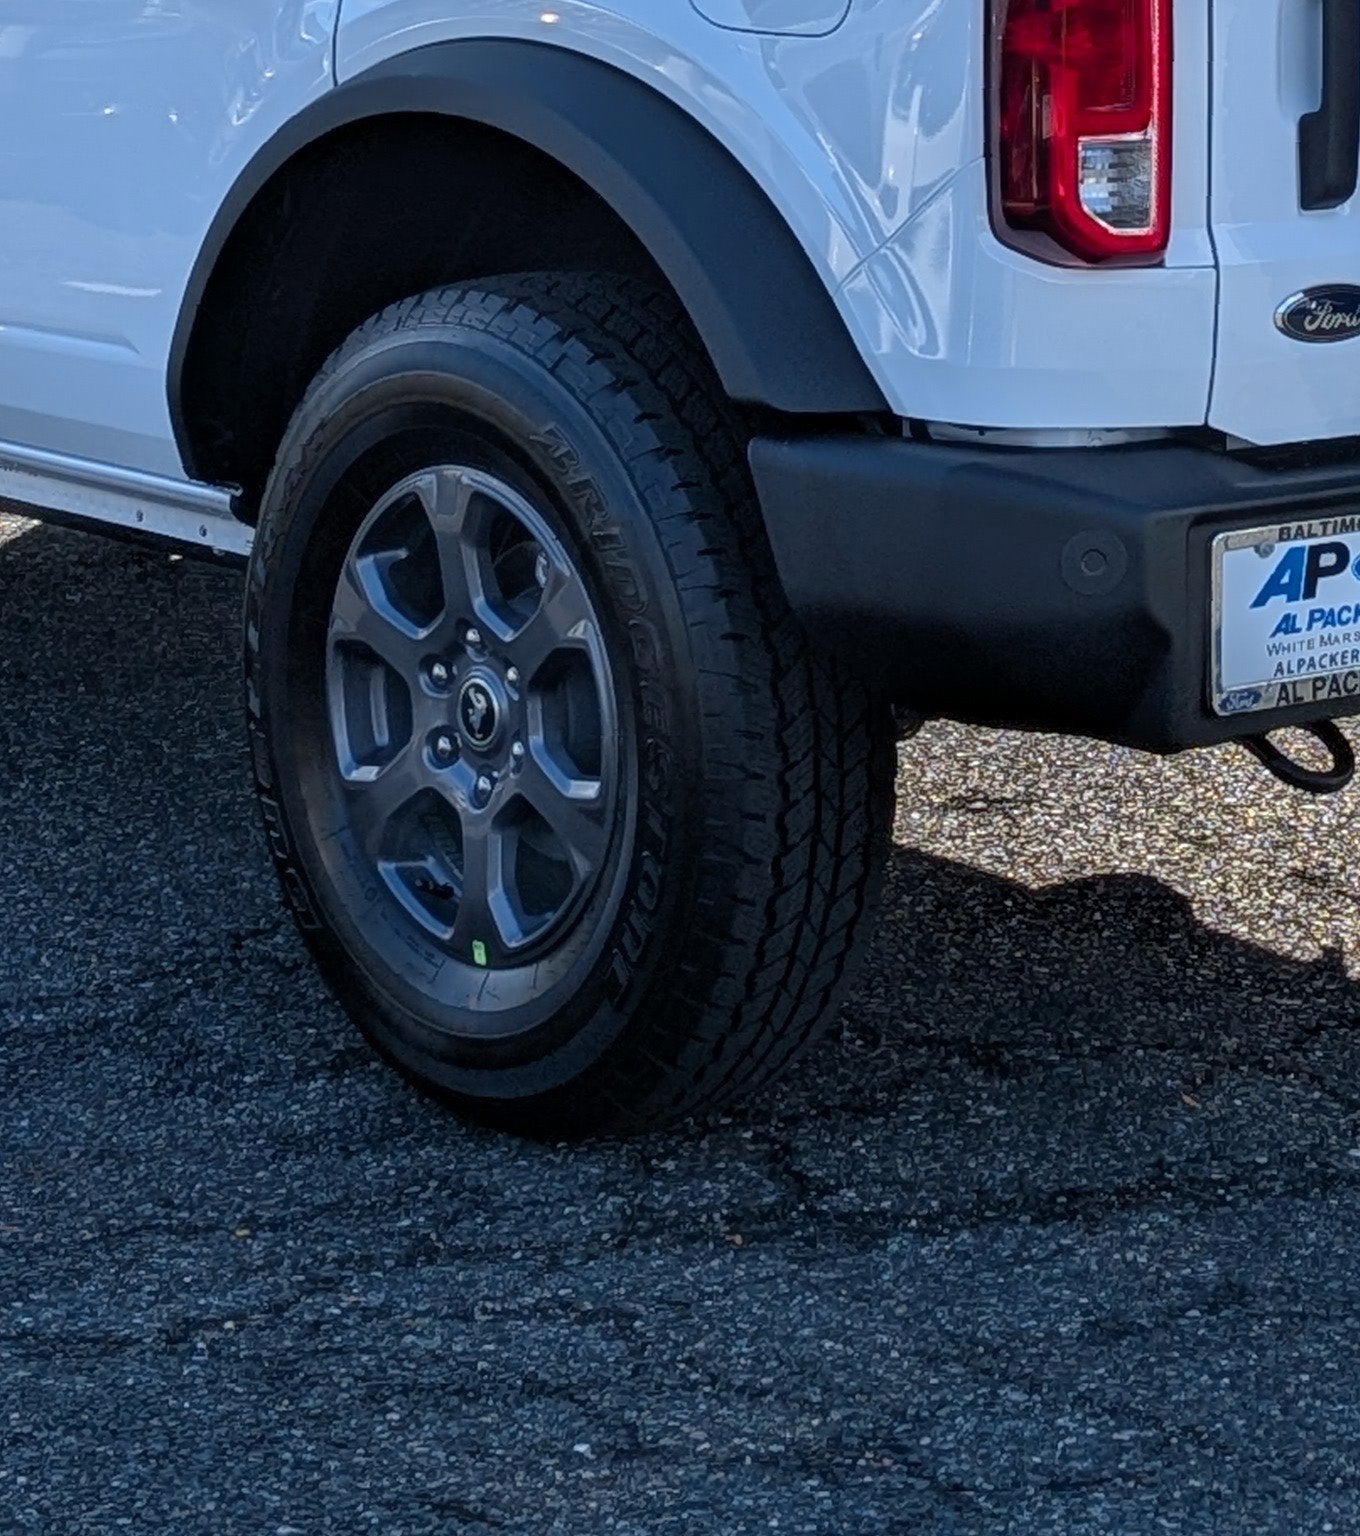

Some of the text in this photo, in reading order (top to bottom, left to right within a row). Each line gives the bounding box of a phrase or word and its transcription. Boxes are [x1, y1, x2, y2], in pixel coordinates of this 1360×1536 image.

[1248, 540, 1351, 609] AP
[1269, 612, 1303, 638] AL
[1266, 638, 1315, 657] WHITE
[1276, 682, 1304, 707] AL
